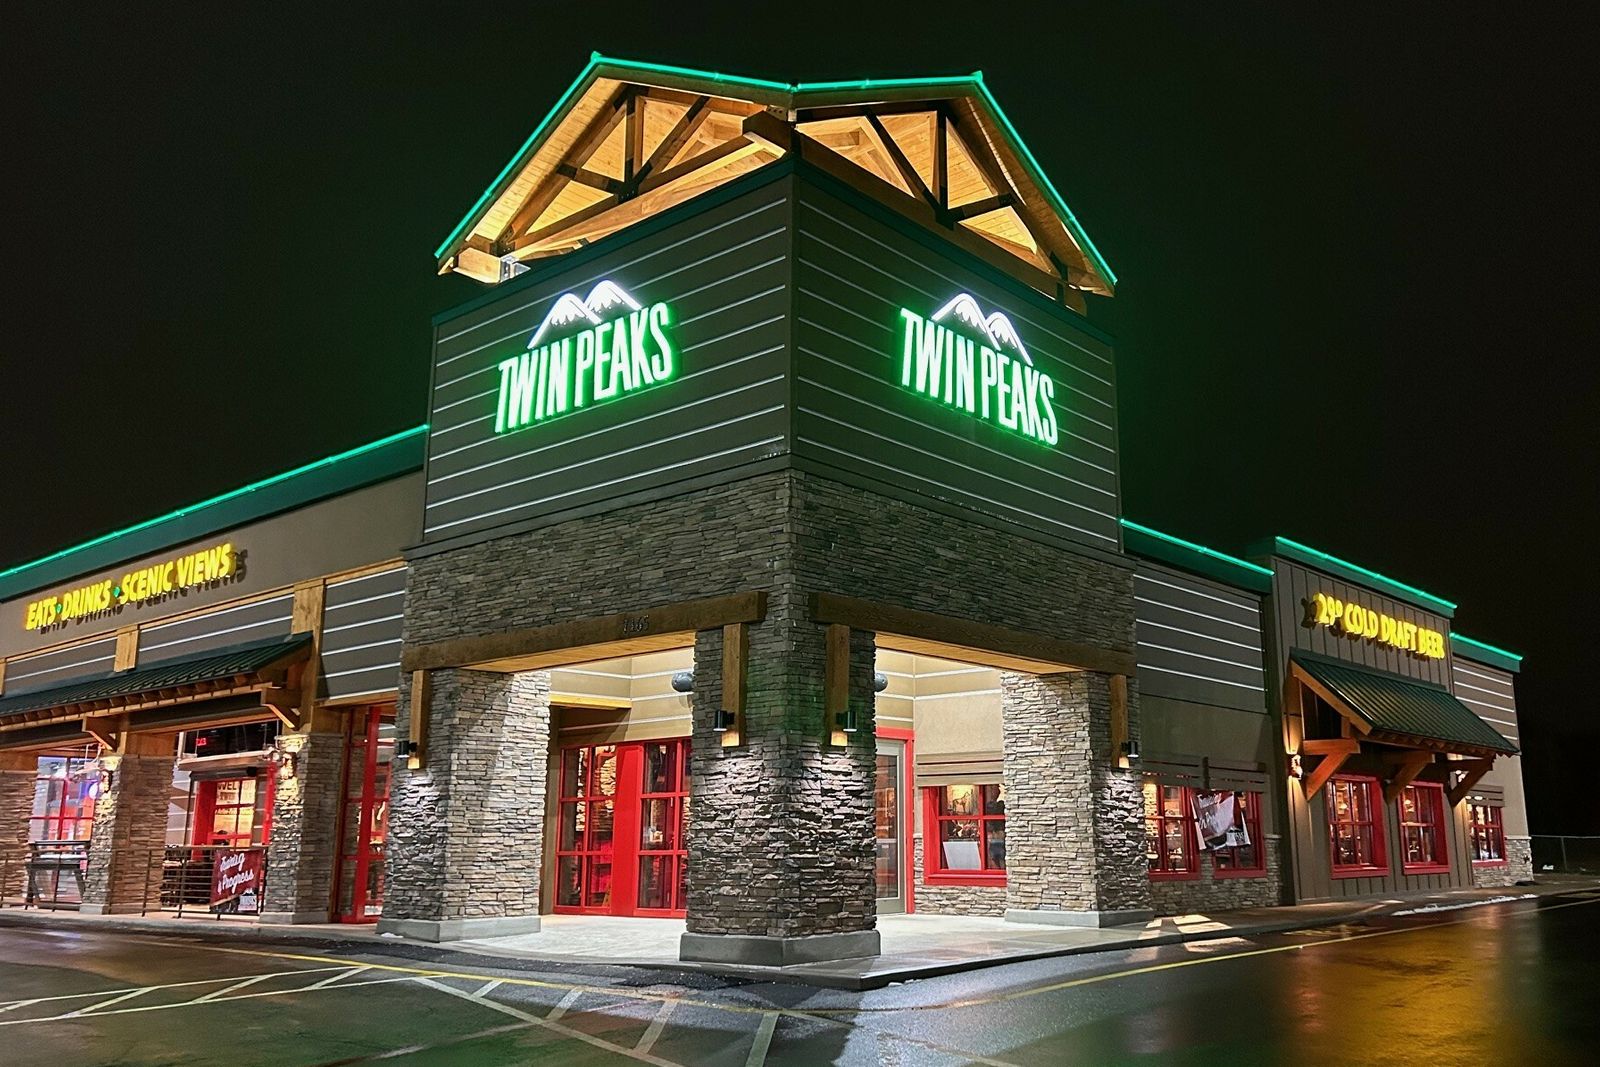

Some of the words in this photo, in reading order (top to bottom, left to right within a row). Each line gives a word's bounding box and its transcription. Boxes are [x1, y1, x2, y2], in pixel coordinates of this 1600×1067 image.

[494, 337, 571, 433] TWIN
[574, 302, 673, 407] PEAKS
[900, 307, 976, 413] TWIN
[980, 345, 1059, 445] PEAKS
[25, 596, 58, 630] EATS
[60, 579, 112, 622] DRINKS
[119, 560, 175, 605] SCENIC
[176, 543, 232, 589] VIEWS
[1344, 603, 1379, 640] COLD
[1379, 614, 1418, 652] DRAFT
[1416, 627, 1446, 660] BEER
